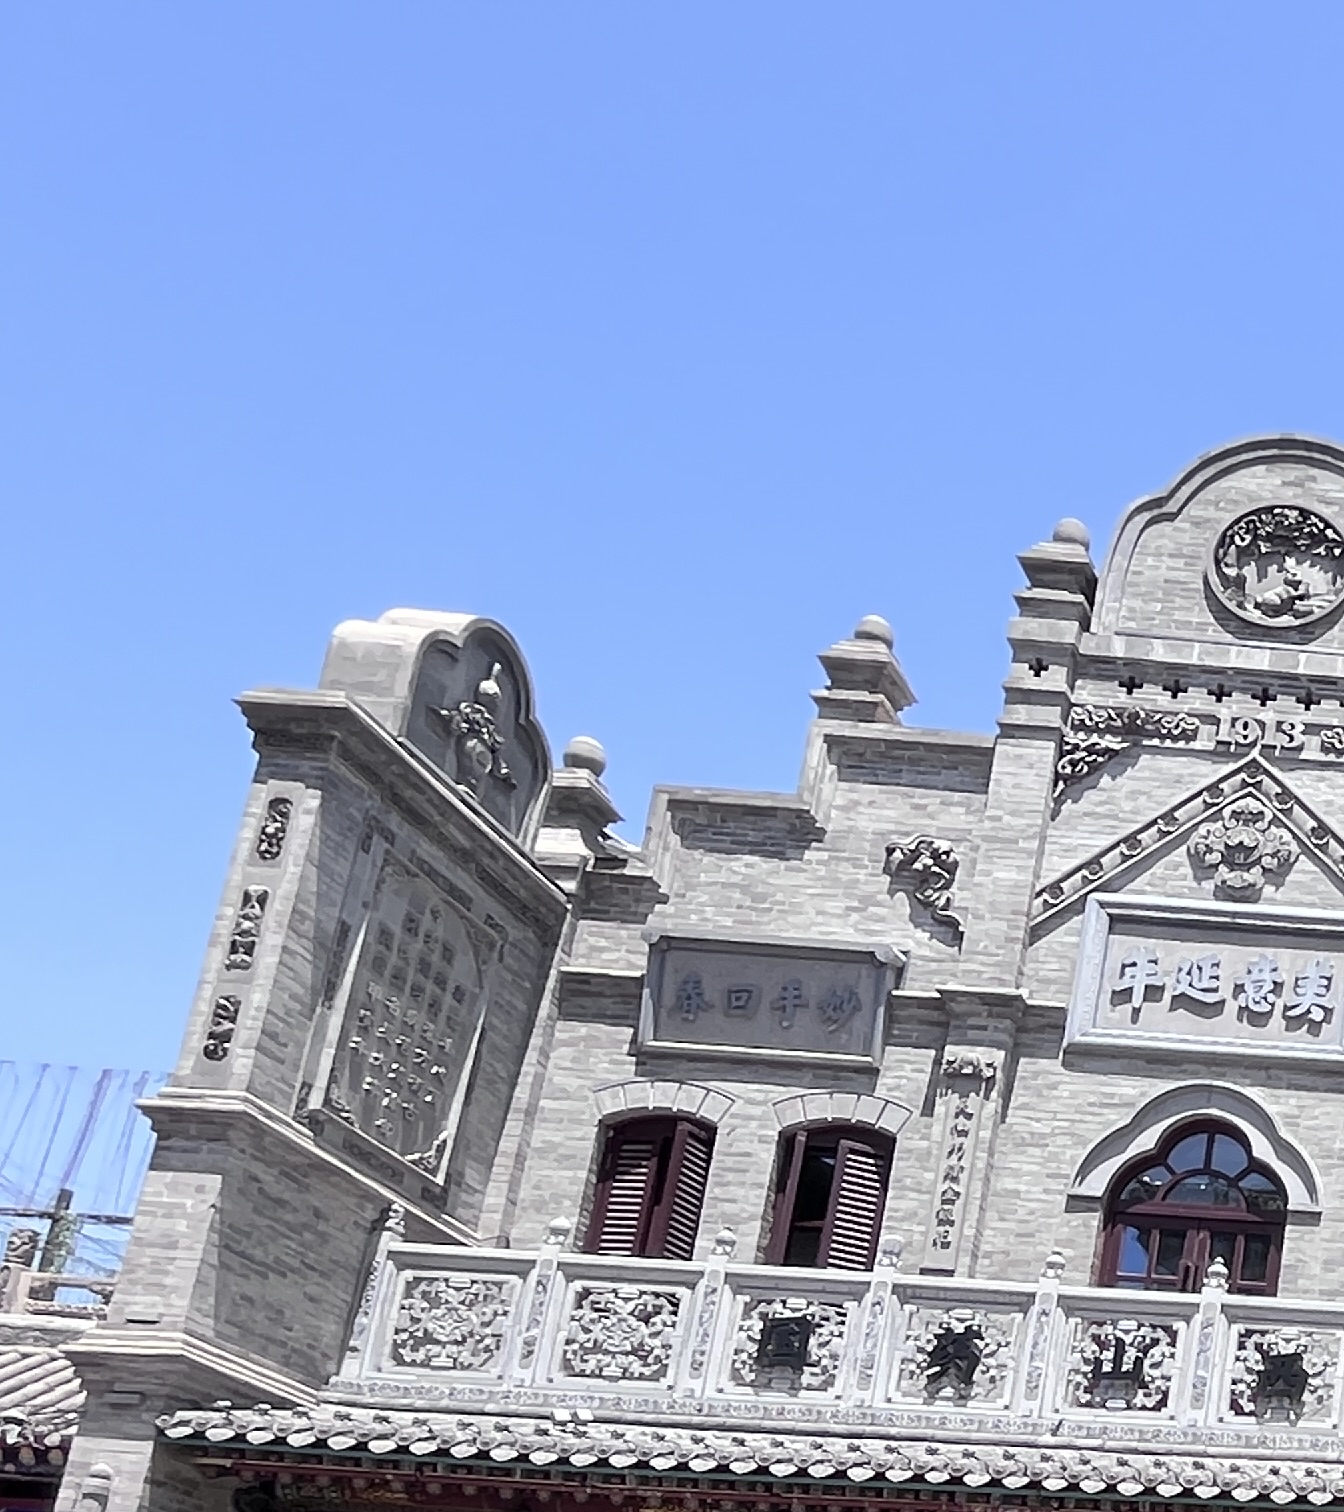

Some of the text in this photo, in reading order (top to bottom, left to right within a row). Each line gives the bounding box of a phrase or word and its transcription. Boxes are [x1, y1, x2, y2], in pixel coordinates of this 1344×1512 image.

[1217, 712, 1305, 749] 1913
[667, 970, 863, 1034] 妙手回春
